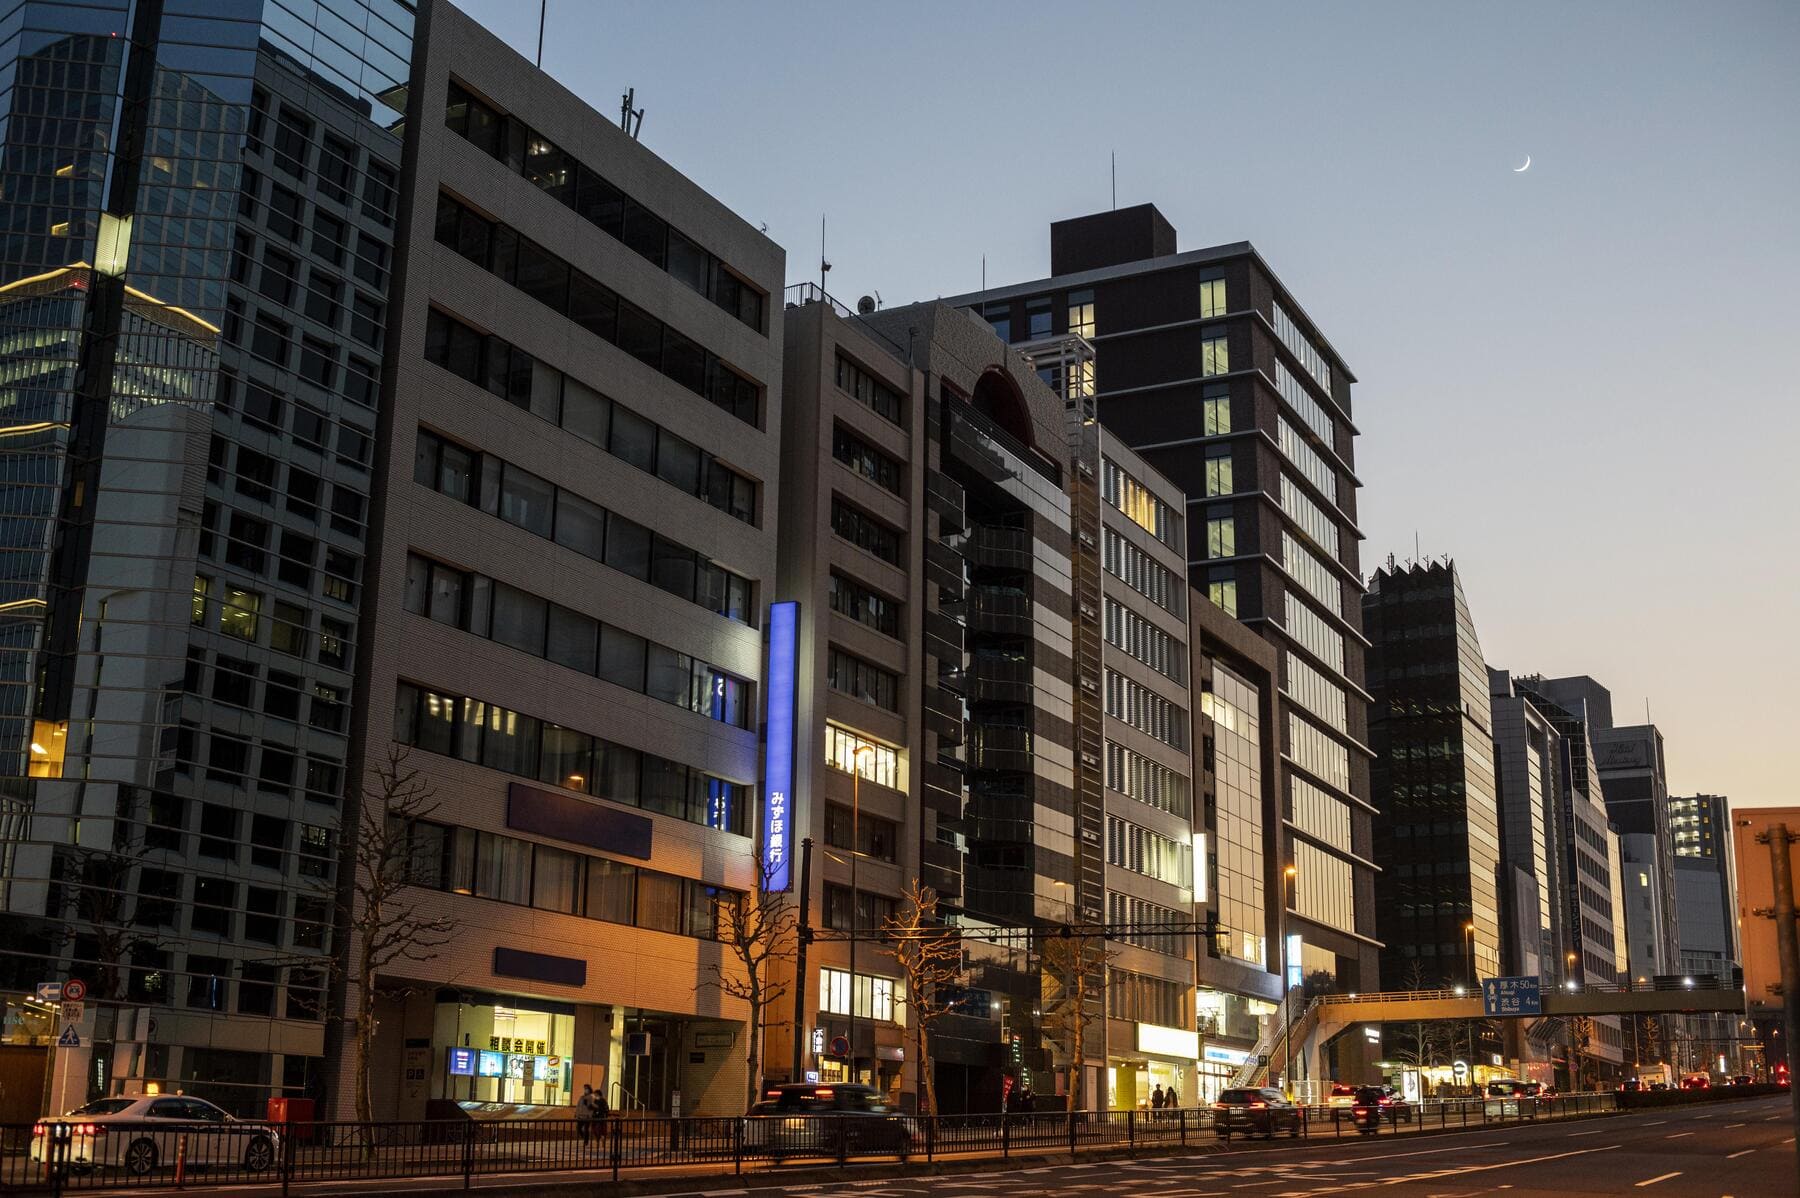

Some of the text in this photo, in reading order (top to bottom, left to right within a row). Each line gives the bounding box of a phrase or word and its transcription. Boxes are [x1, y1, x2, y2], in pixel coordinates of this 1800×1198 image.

[769, 791, 785, 863] みずほ銀行
[489, 1036, 546, 1055] 相談会開催
